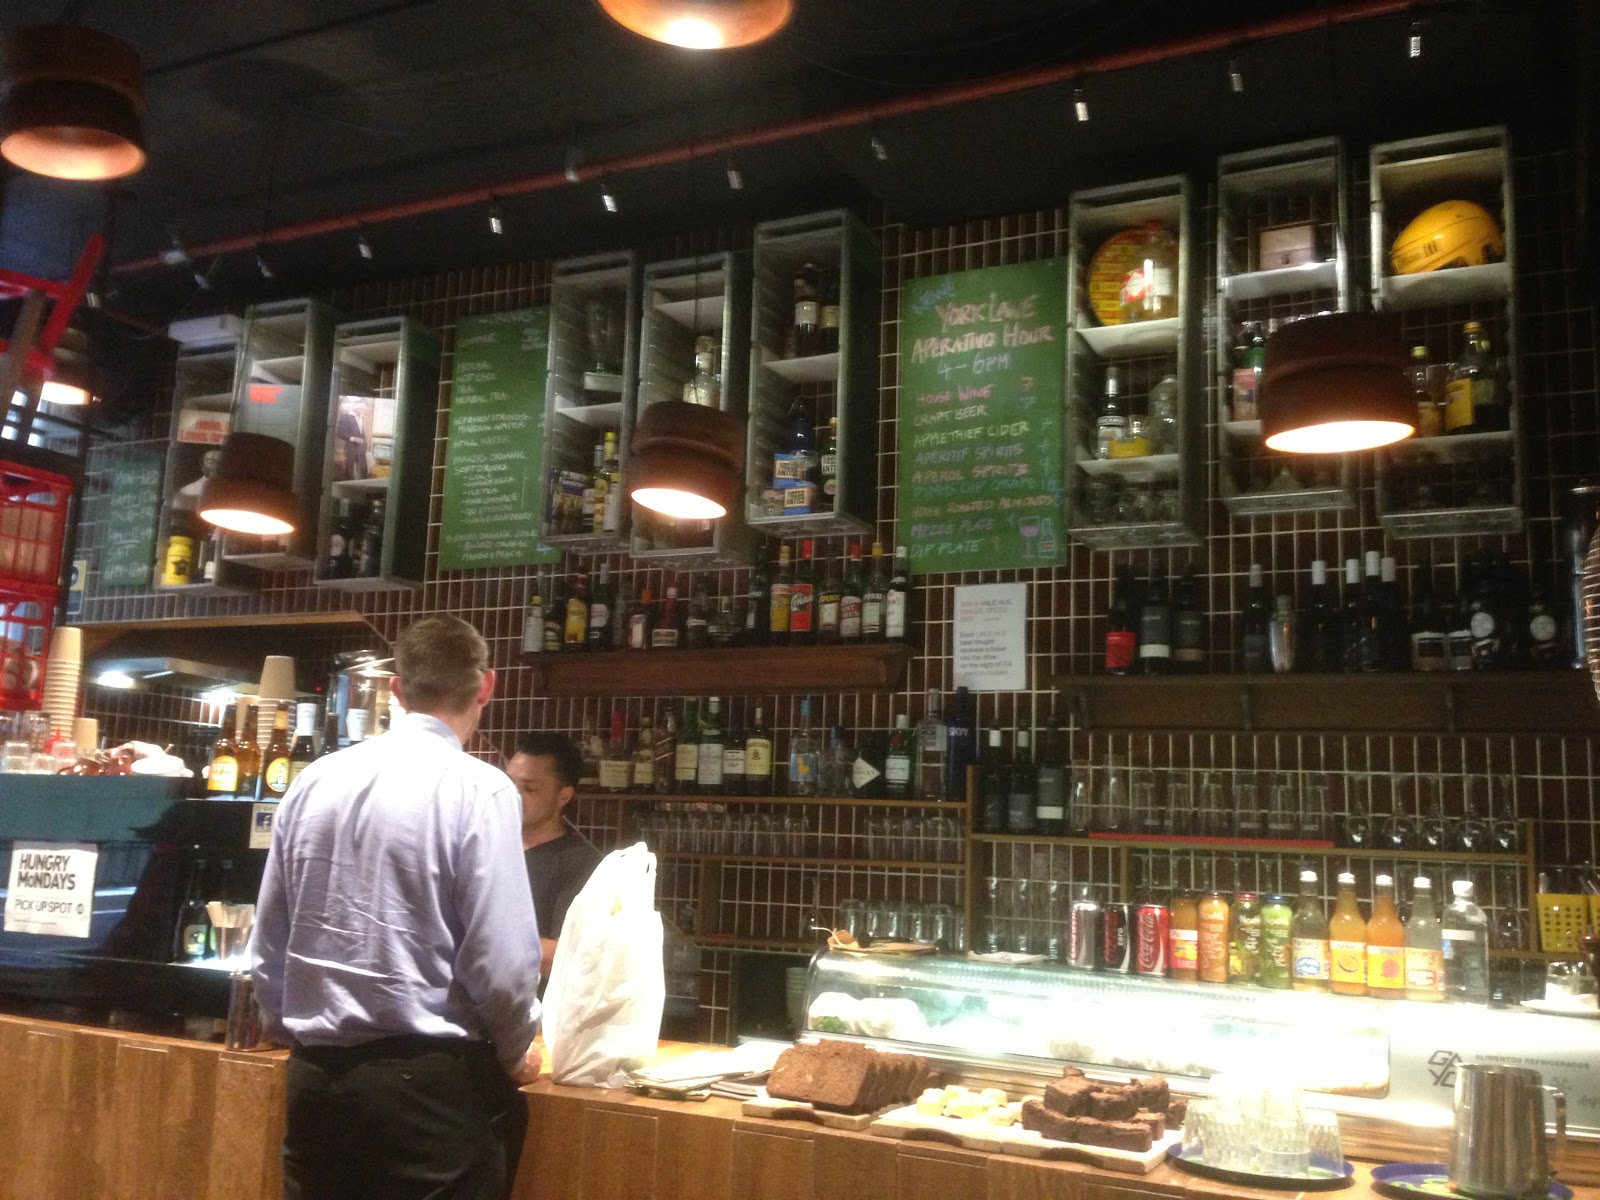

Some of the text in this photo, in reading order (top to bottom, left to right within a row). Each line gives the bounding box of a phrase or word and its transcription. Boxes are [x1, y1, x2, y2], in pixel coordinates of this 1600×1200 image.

[934, 302, 988, 333] YORK
[1003, 322, 1053, 347] HOUR
[955, 405, 989, 420] BEER
[987, 420, 1030, 437] CIDER
[910, 543, 936, 558] DIP
[938, 539, 984, 556] PLATE
[19, 853, 71, 872] HUNGRY
[14, 899, 73, 914] PICK UP SPOT
[1475, 1054, 1522, 1064] ALIMENTOS
